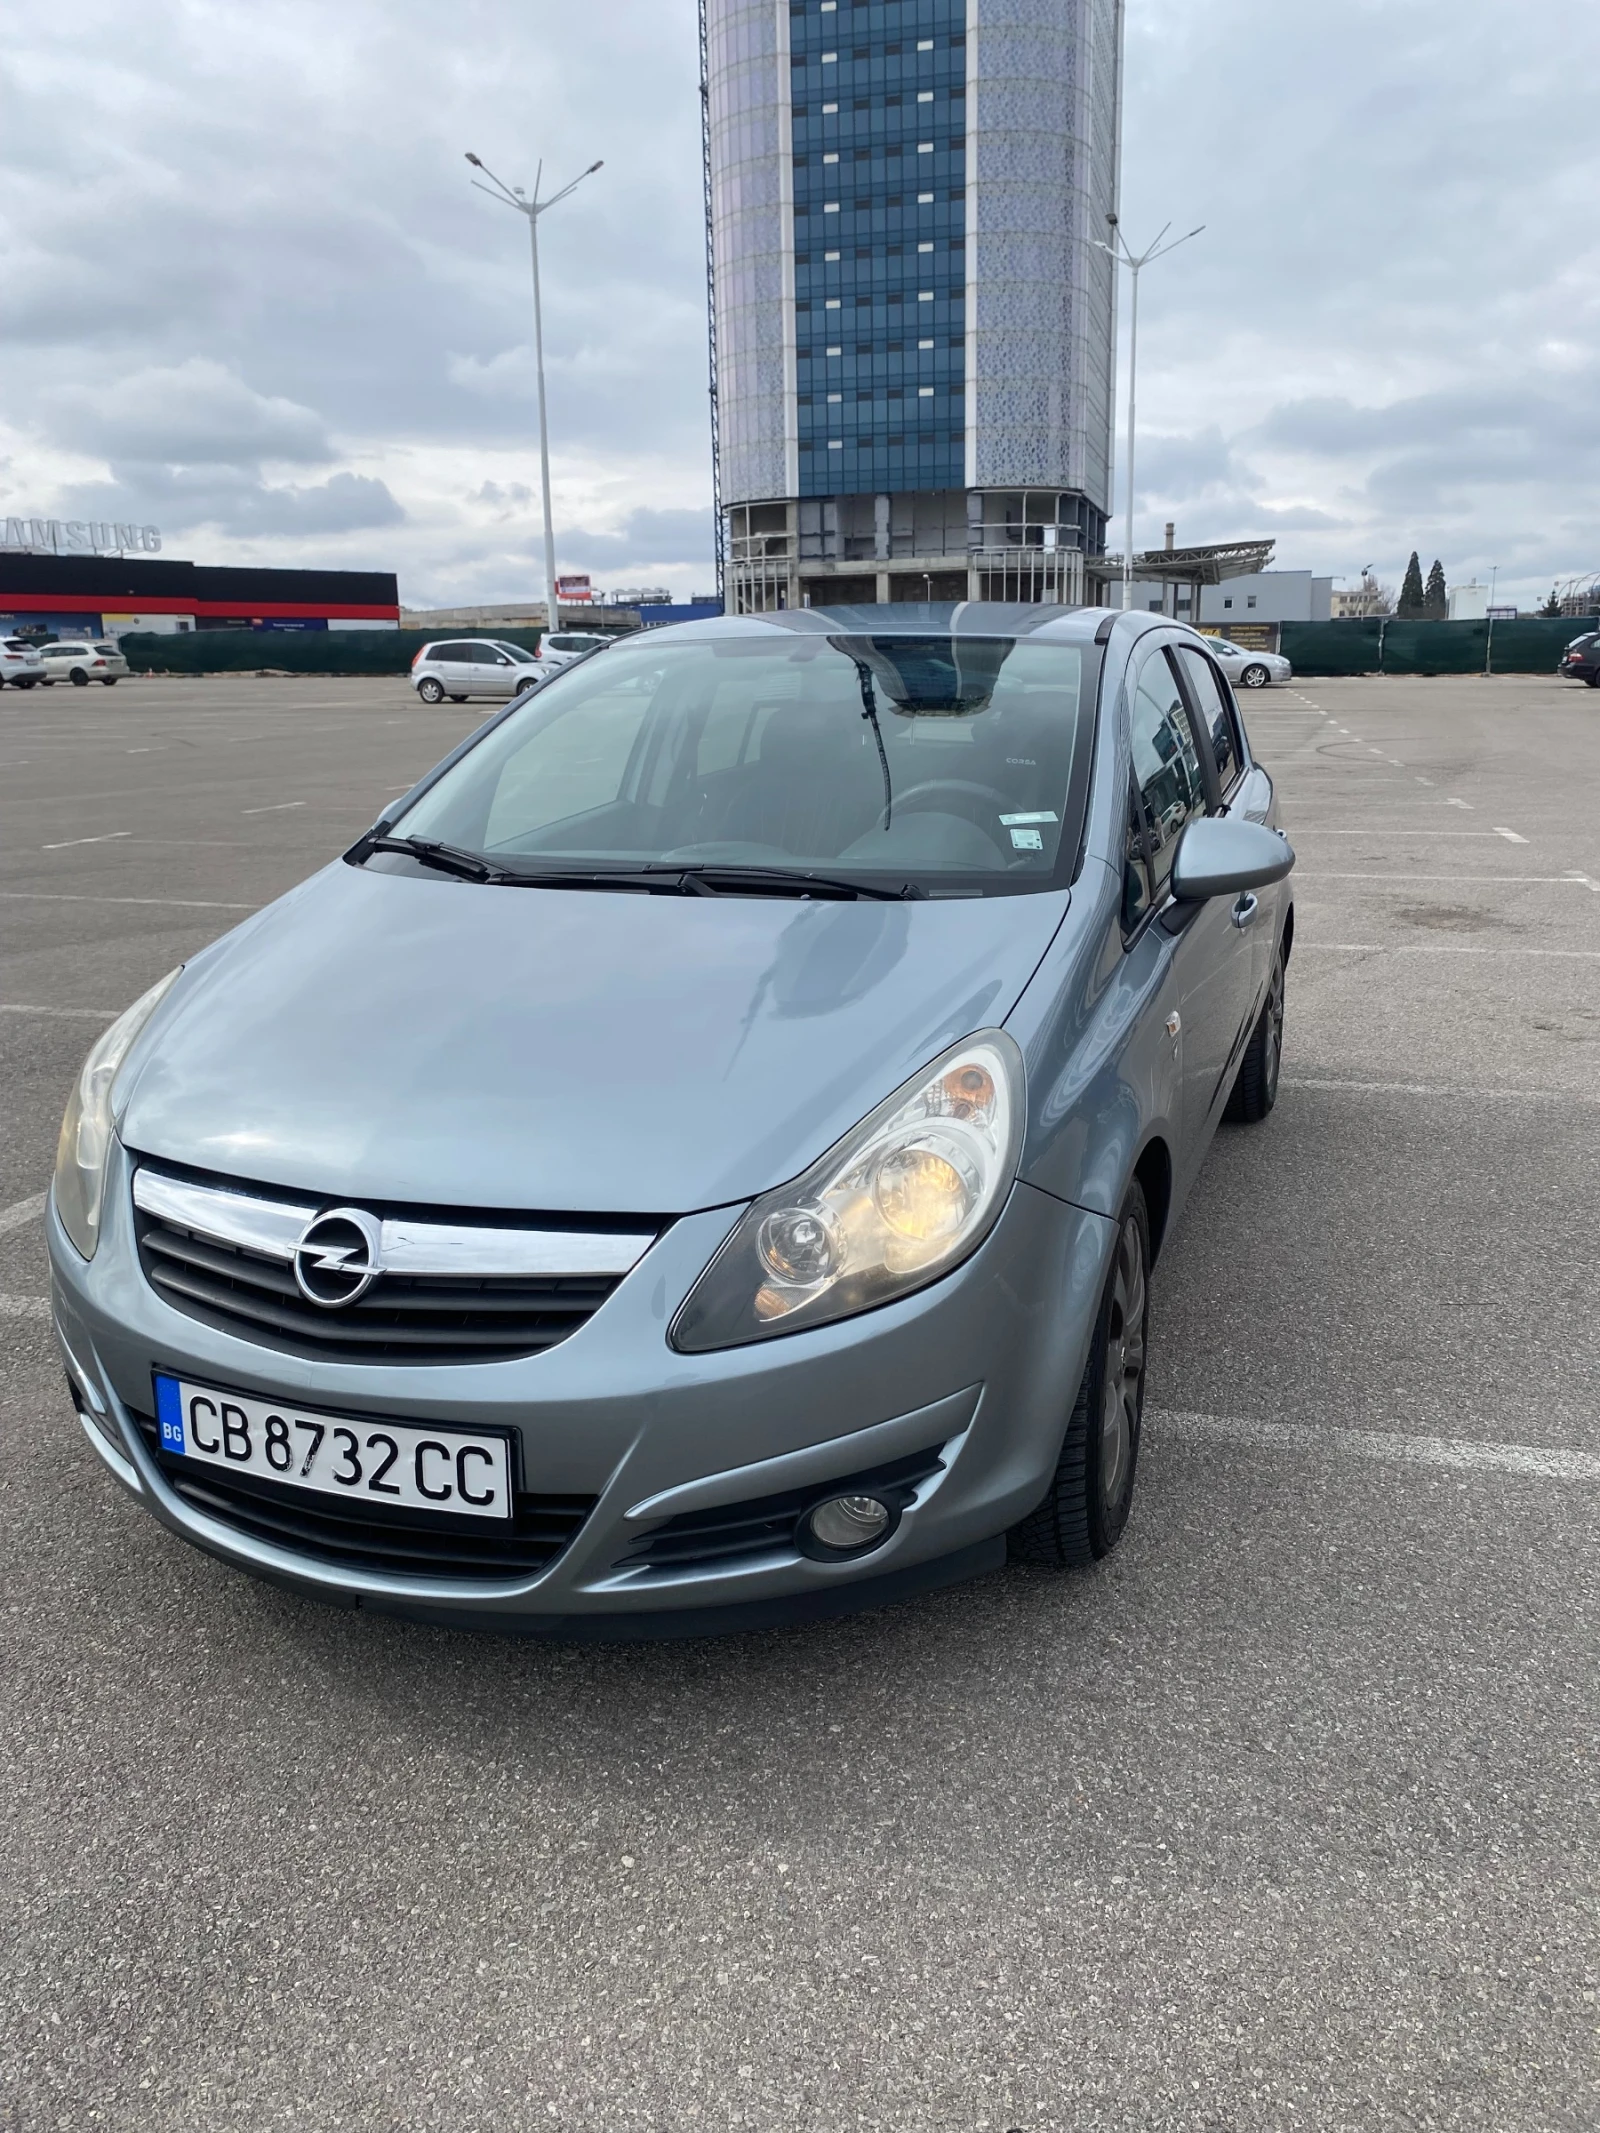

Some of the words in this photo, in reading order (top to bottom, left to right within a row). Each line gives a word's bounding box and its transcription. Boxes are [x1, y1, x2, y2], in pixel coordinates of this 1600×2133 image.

[0, 517, 162, 553] AMSUNG
[1006, 757, 1036, 766] CORSA
[162, 1422, 182, 1442] BG
[190, 1396, 252, 1462] CB
[265, 1414, 400, 1495] 8732
[415, 1440, 495, 1506] CC
